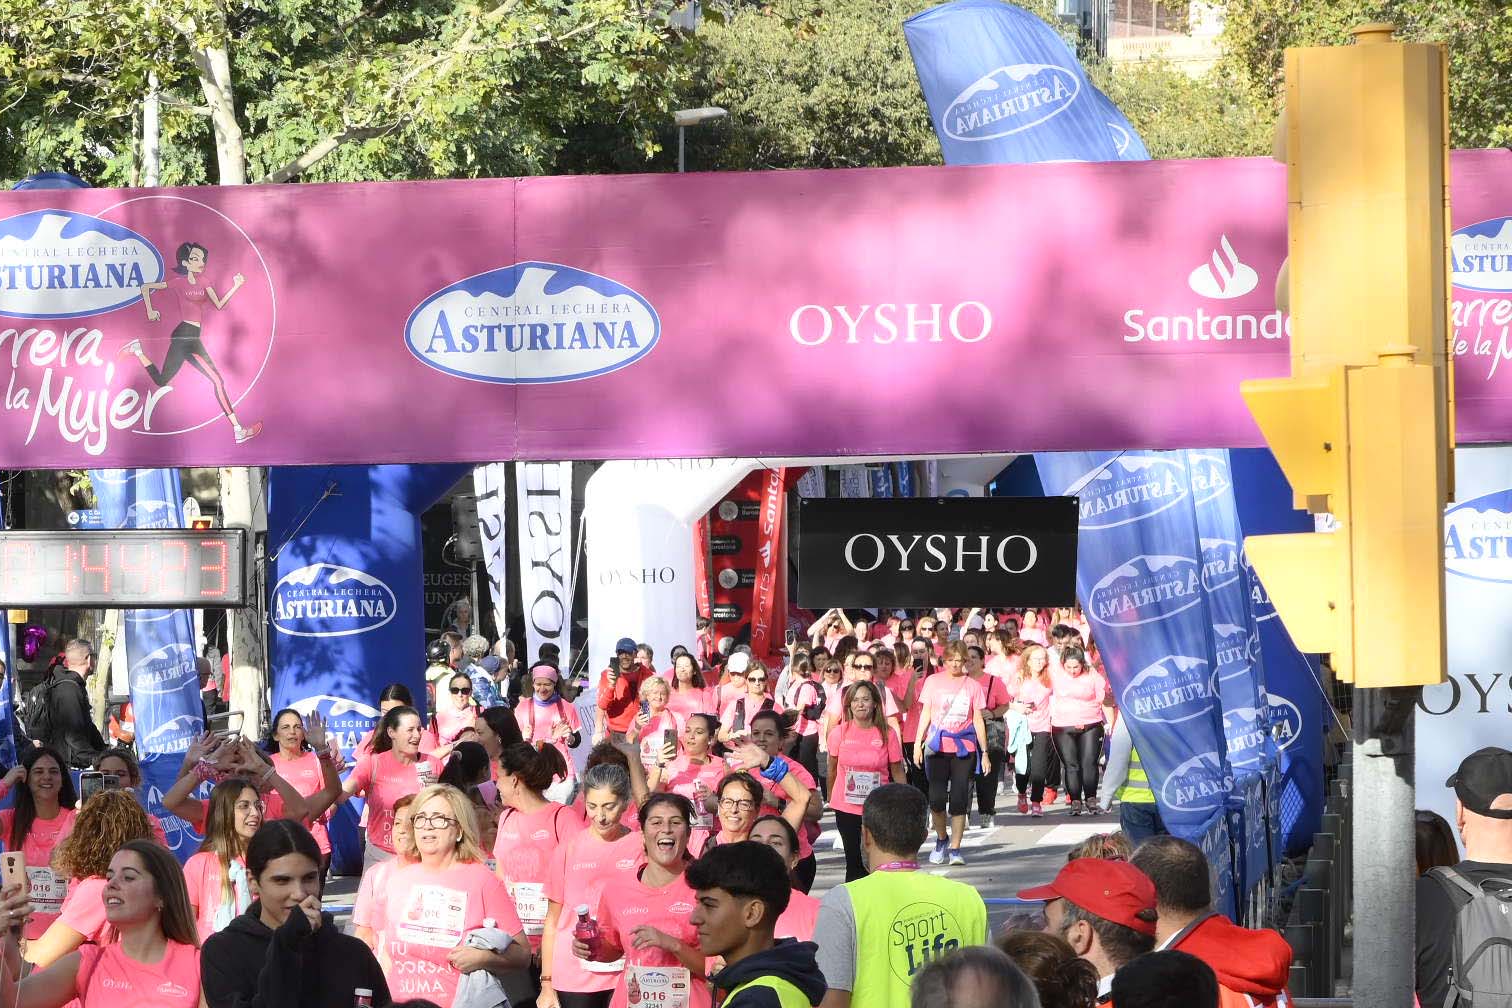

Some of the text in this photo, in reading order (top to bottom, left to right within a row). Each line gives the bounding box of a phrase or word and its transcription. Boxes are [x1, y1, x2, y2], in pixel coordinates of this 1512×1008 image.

[465, 303, 632, 317] CENTRAL LECHERA
[790, 301, 992, 345] OYSHO
[425, 309, 640, 353] ASTURIANA
[6, 369, 30, 410] la
[25, 361, 173, 456] Mujer
[845, 534, 1038, 575] OYSHO
[275, 593, 387, 622] ASTURIANA
[333, 588, 383, 598] LECHERA
[893, 911, 947, 946] Sport
[643, 991, 666, 1001] 016
